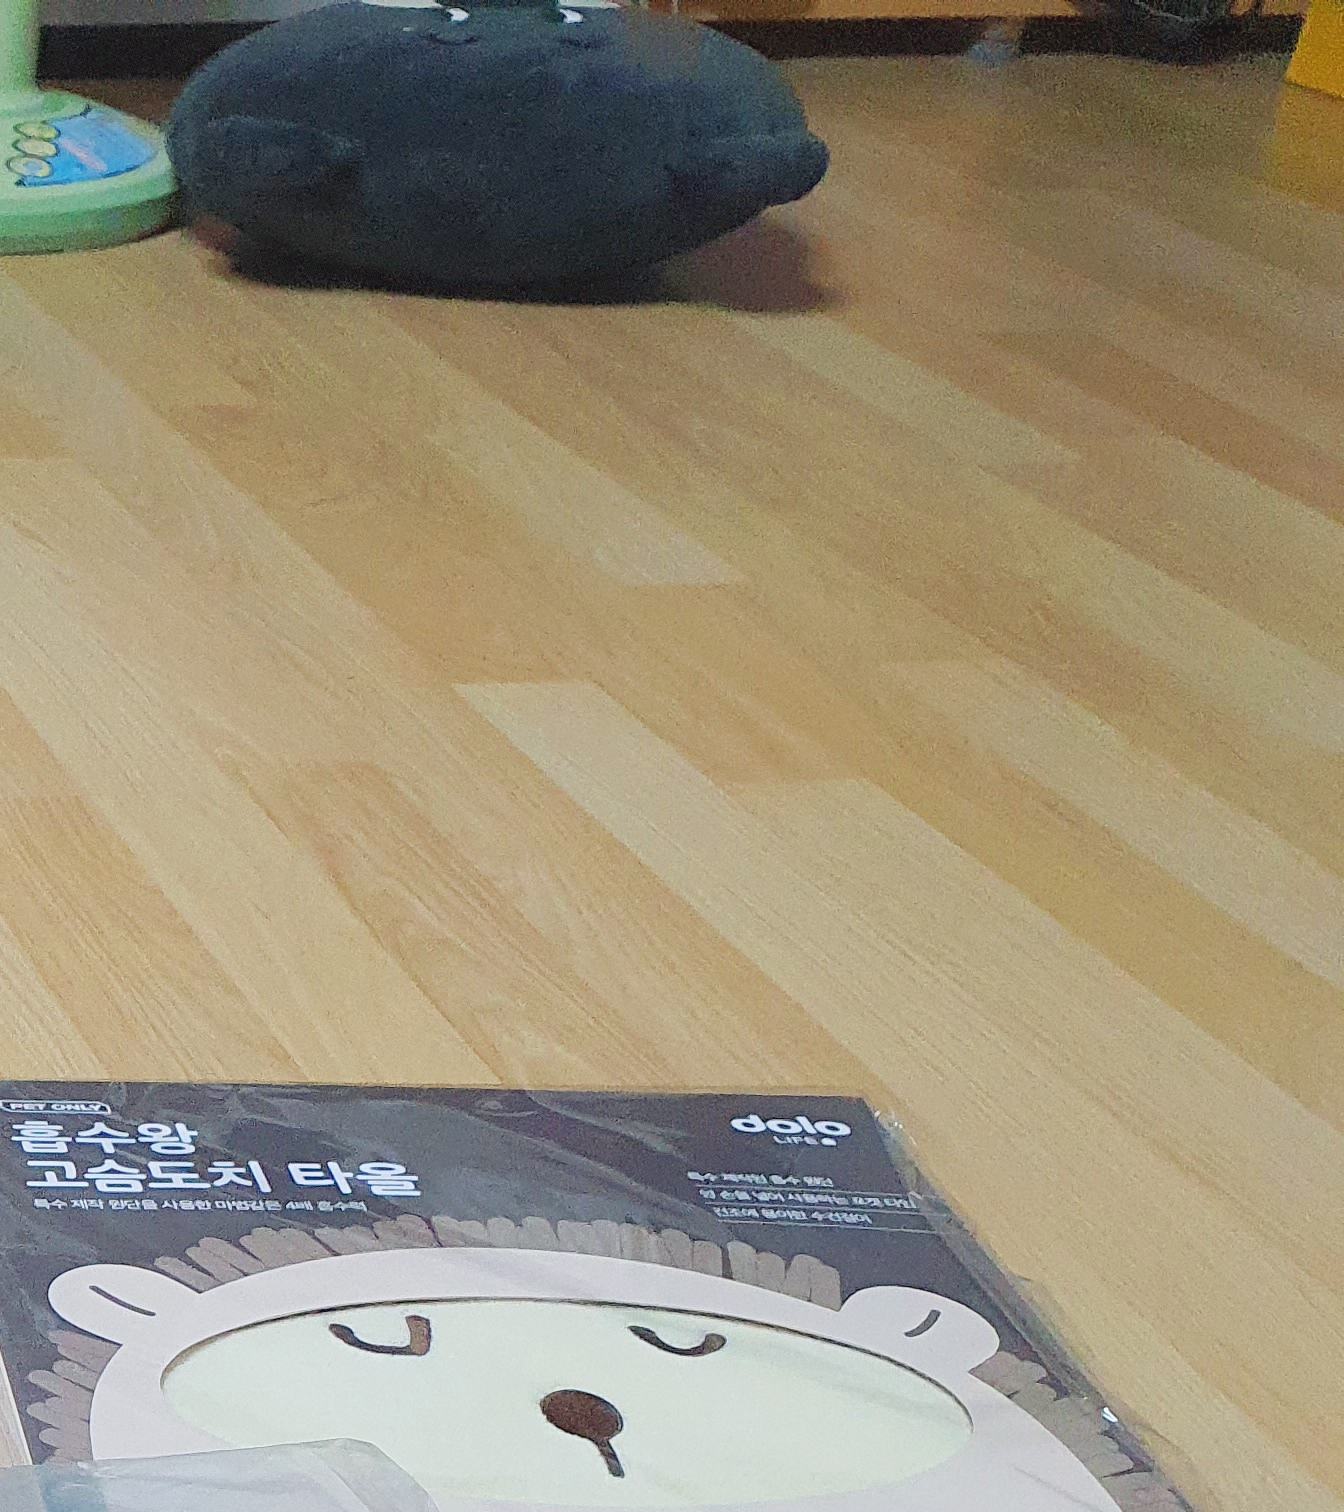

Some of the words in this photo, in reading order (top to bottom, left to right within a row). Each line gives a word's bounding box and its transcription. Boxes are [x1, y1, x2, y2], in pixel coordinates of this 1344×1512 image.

[50, 1103, 104, 1112] ONLY
[730, 1114, 852, 1136] dolo
[11, 1120, 198, 1155] 흡수왕
[26, 1159, 272, 1194] 고슴도치
[288, 1160, 422, 1196] 타올
[70, 1198, 104, 1210] 제작
[108, 1199, 158, 1210] 원단을
[161, 1199, 212, 1211] 사용한
